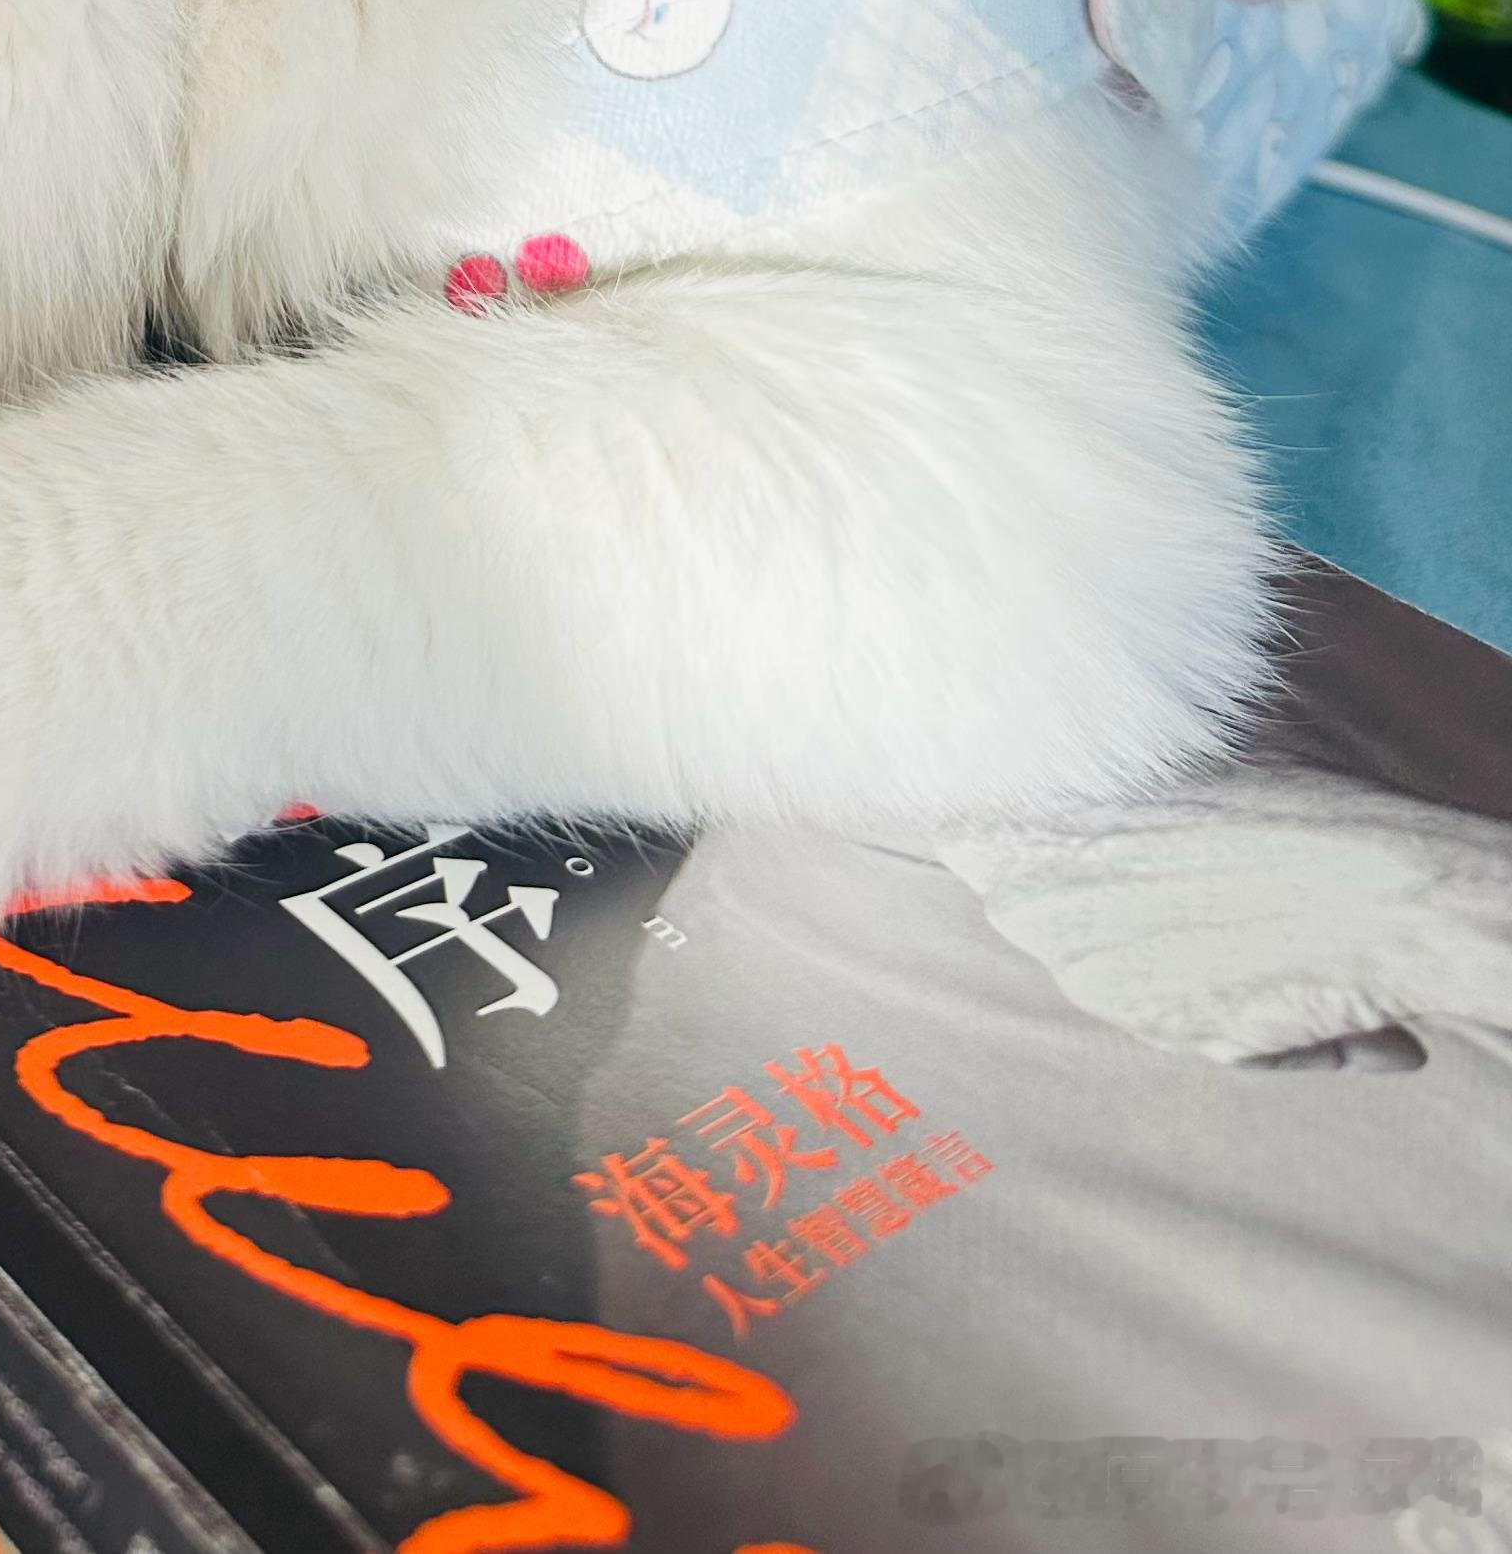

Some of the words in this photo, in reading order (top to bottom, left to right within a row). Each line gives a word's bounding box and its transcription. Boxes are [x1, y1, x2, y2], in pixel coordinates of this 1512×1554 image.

[278, 822, 560, 1068] 序
[571, 1043, 920, 1270] 海灵格
